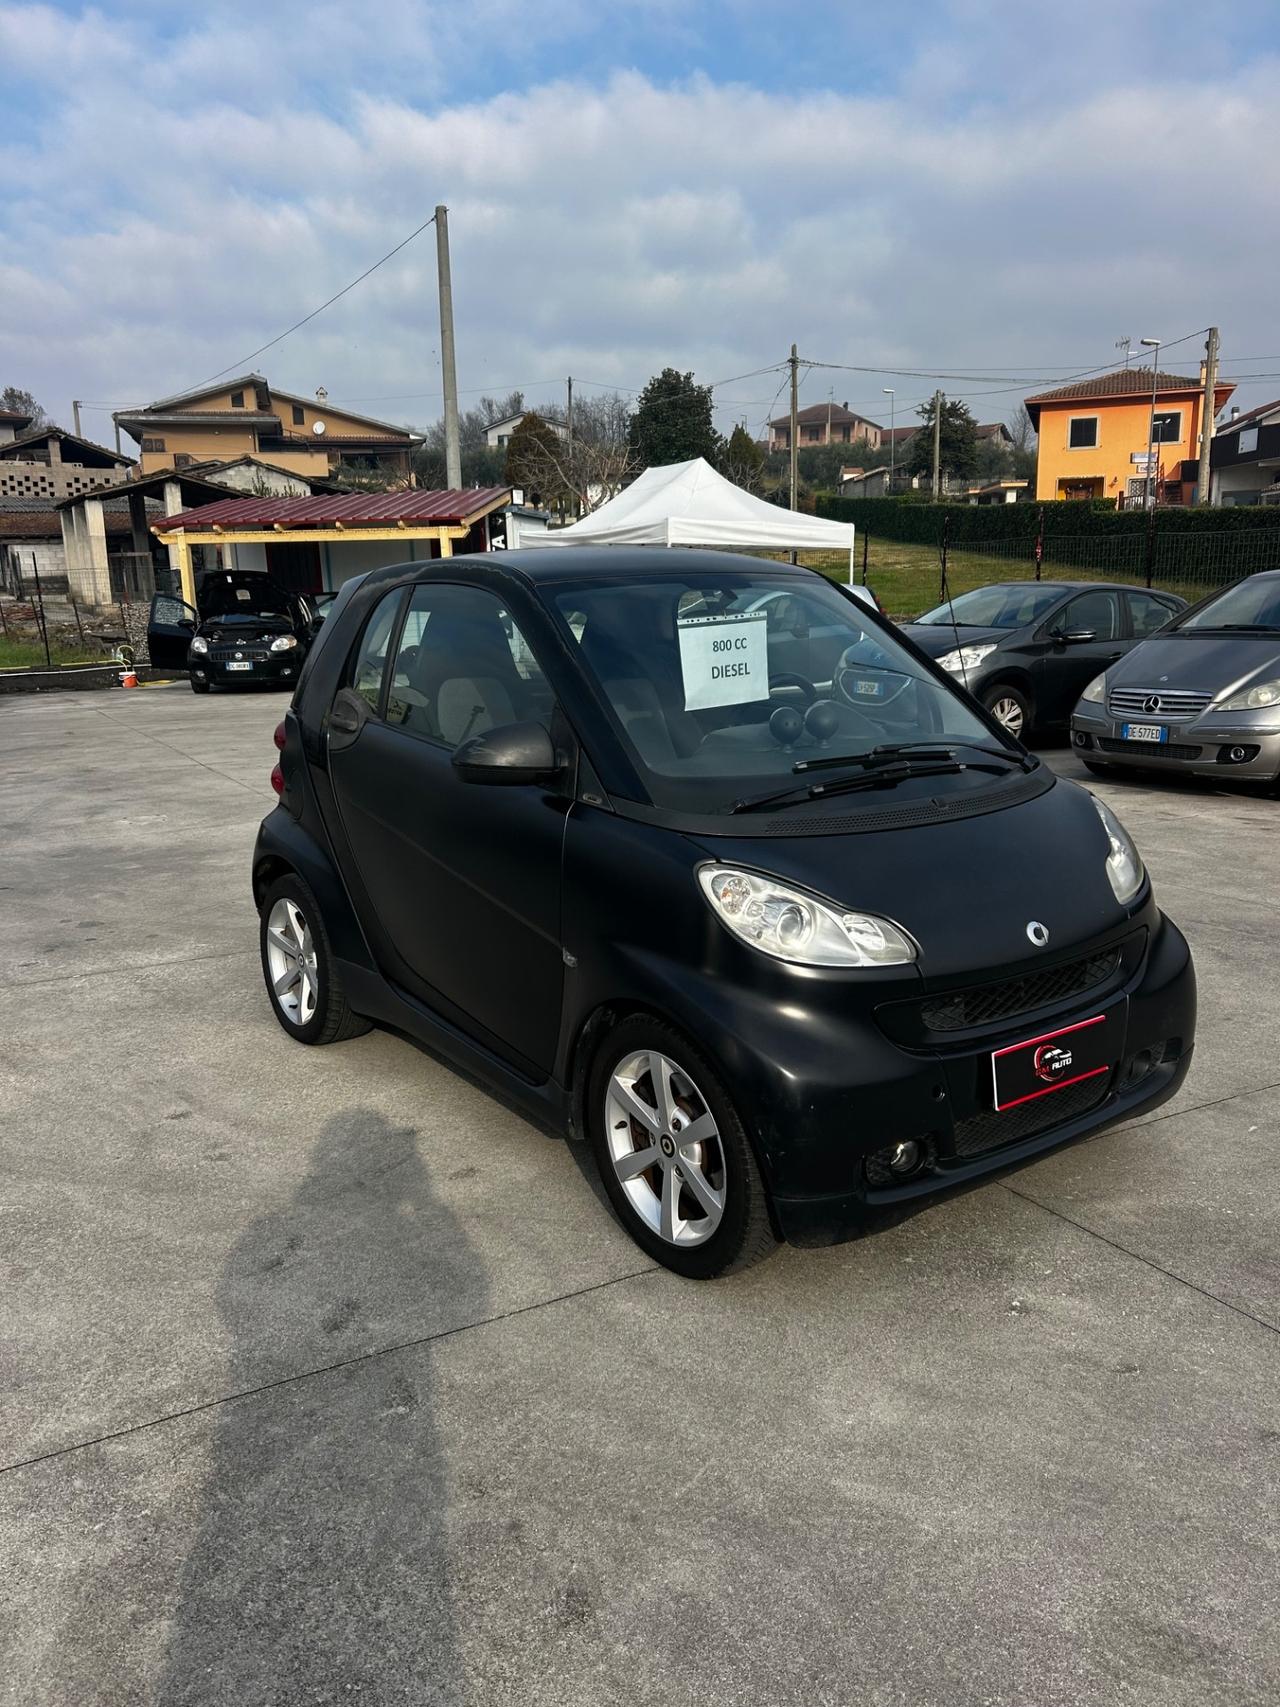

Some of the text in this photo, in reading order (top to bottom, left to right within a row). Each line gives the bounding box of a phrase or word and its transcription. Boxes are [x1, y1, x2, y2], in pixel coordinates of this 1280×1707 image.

[712, 637, 748, 652] 800 CC
[711, 662, 751, 679] DIESEL
[1052, 1057, 1072, 1070] AUTO
